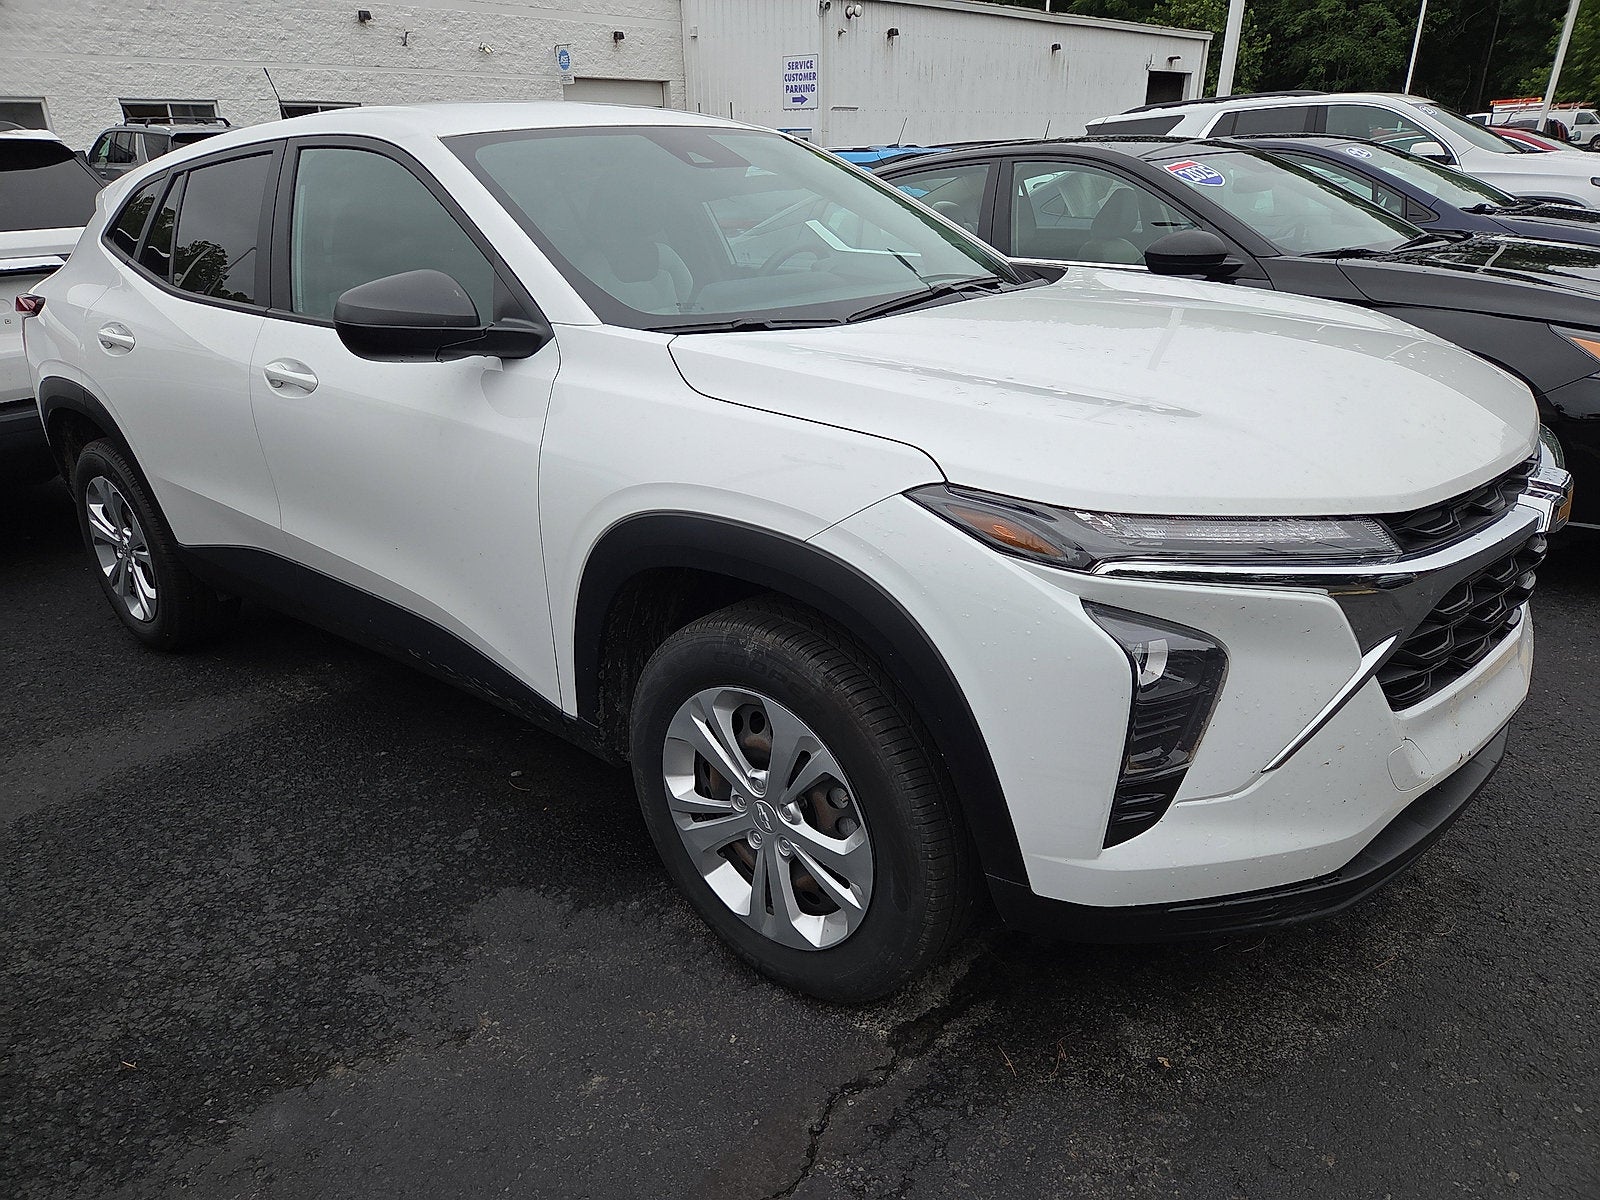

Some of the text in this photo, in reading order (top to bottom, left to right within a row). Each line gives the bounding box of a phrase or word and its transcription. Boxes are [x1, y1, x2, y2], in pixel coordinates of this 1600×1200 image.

[787, 60, 814, 70] SERVICE
[784, 72, 817, 82] CUSTOMER
[785, 84, 816, 93] PARKING
